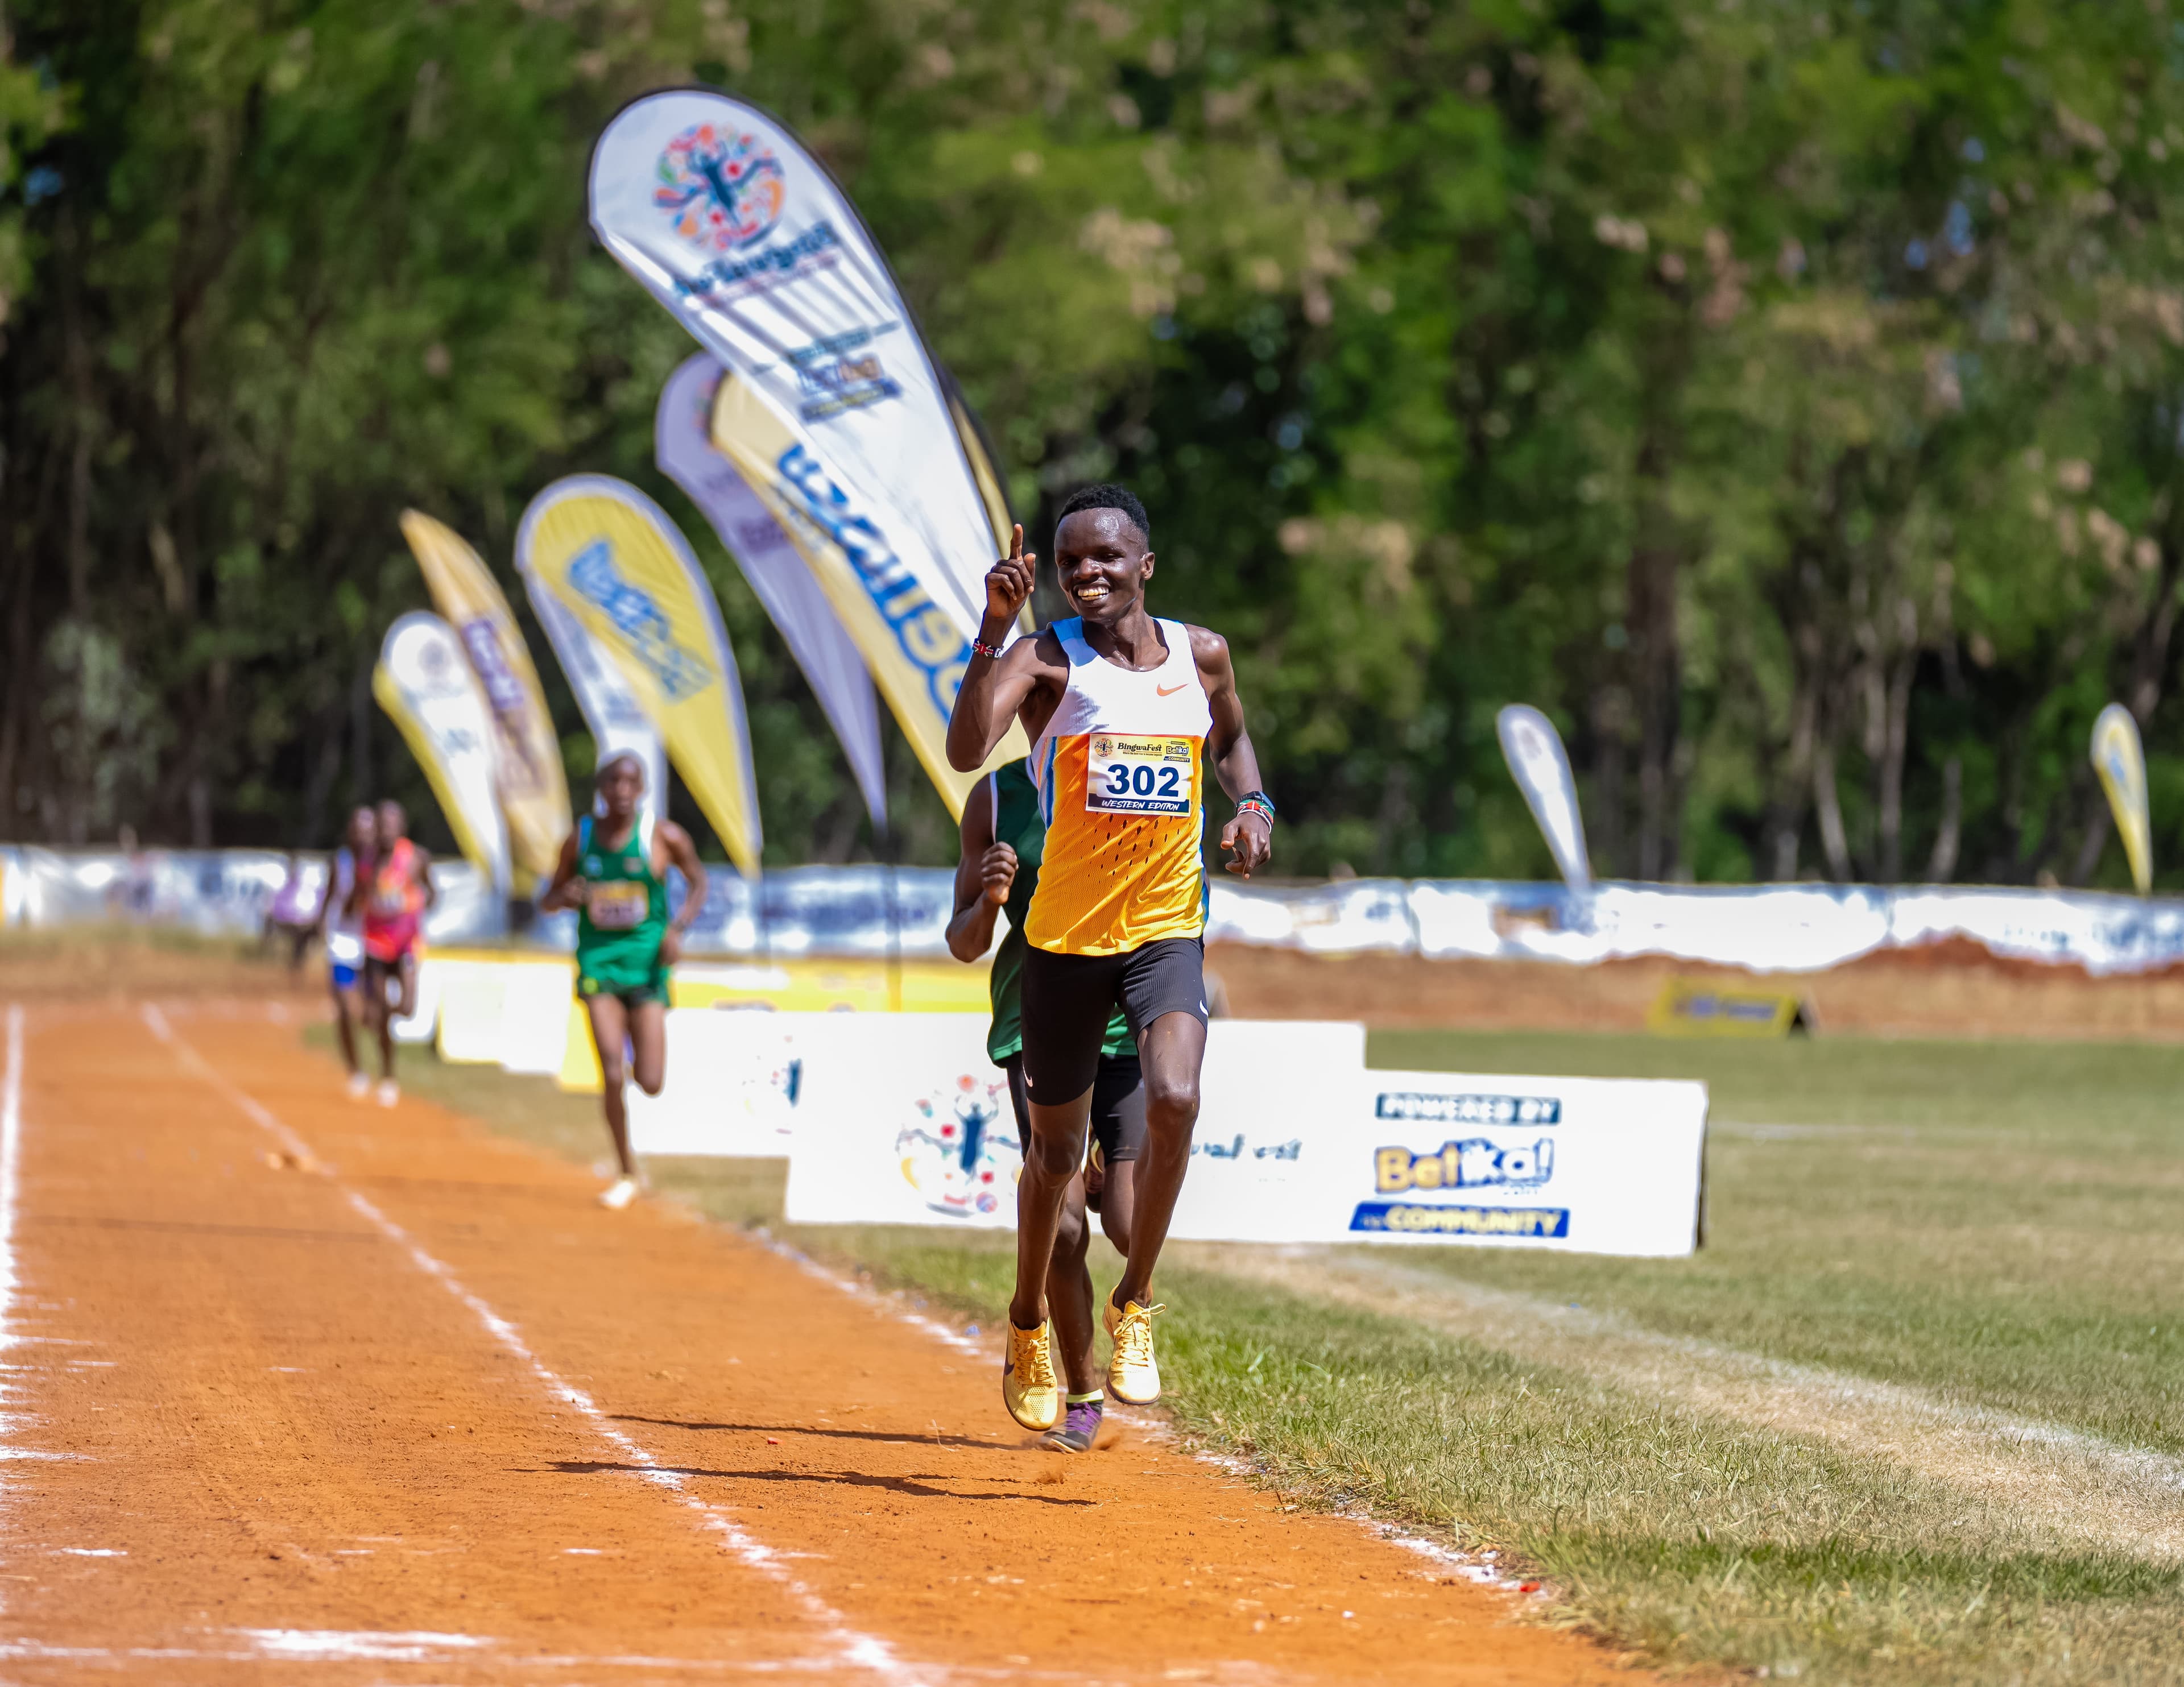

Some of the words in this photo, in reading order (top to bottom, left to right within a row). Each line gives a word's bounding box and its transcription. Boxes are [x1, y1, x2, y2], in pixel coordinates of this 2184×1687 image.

[1118, 743, 1162, 752] BingwaFest
[1166, 746, 1189, 755] Betika!
[1106, 764, 1179, 797] 302
[1102, 799, 1145, 809] WESTERN
